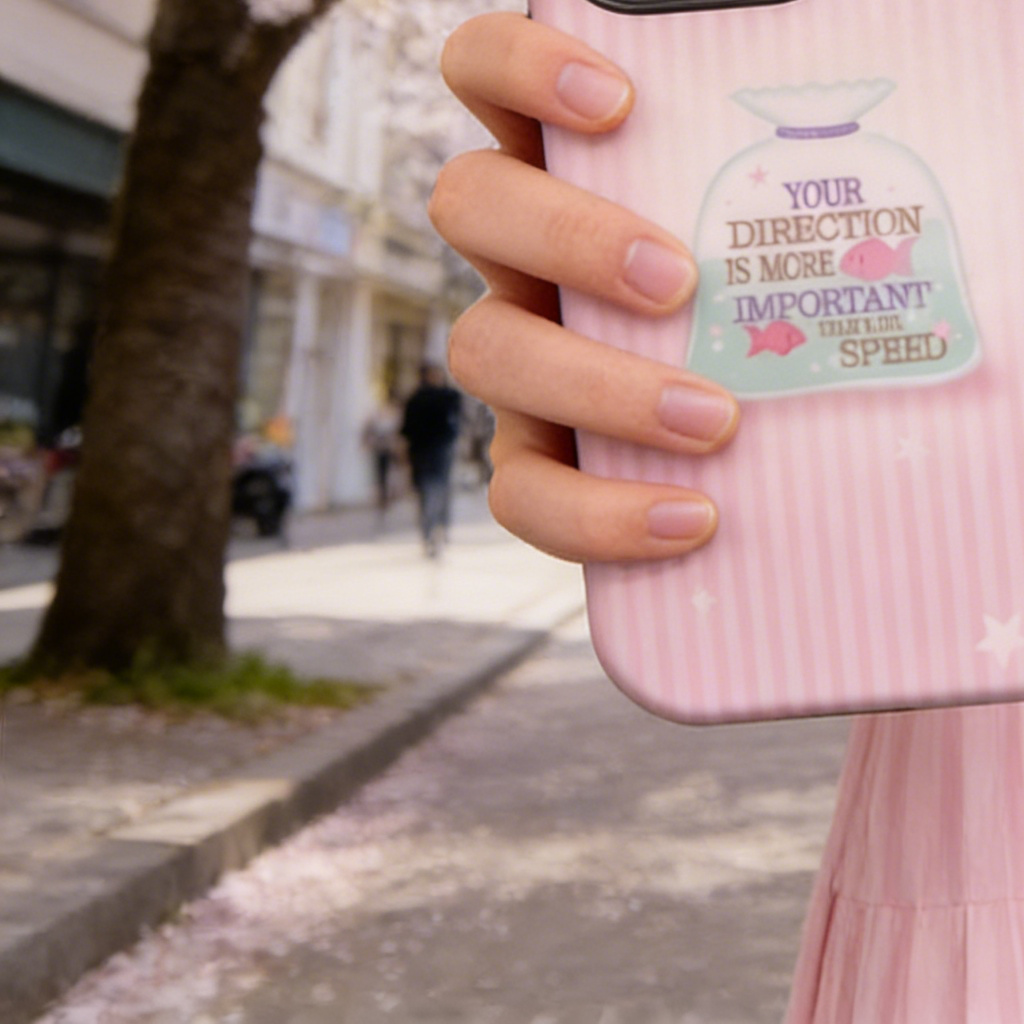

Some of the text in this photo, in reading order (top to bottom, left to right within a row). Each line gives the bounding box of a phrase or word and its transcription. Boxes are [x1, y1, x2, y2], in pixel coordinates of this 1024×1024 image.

[782, 177, 865, 209] YOUR
[726, 205, 924, 249] DIRECTION
[725, 250, 836, 286] IS MORE
[733, 281, 932, 323] IMPORTANT
[839, 332, 948, 368] SPEED
